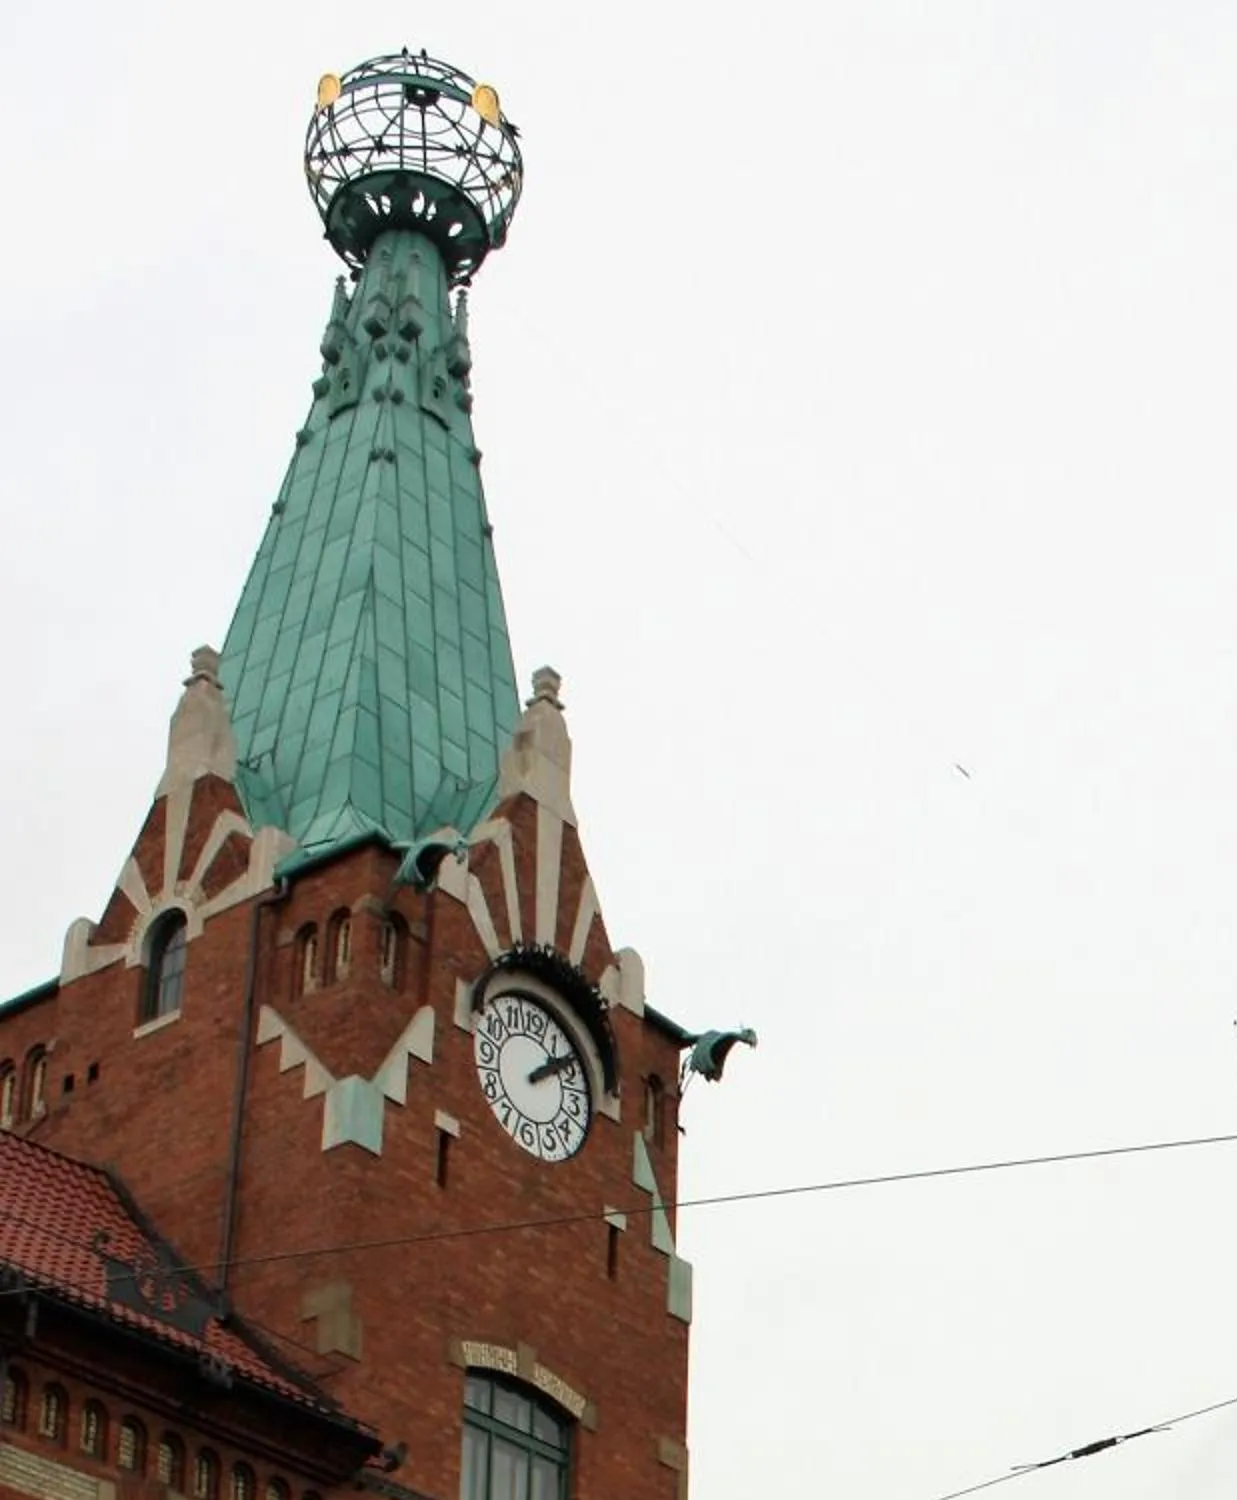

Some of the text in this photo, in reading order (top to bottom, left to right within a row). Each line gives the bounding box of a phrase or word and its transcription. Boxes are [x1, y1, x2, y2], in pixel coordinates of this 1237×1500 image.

[486, 1014, 503, 1041] 10
[506, 1005, 520, 1029] 11
[525, 1010, 544, 1035] 12
[479, 1042, 495, 1065] 9
[484, 1073, 497, 1099] 8
[500, 1103, 513, 1127] 7
[569, 1093, 580, 1116] 3
[519, 1125, 534, 1146] 6
[542, 1127, 557, 1151] 5
[558, 1118, 572, 1142] 4
